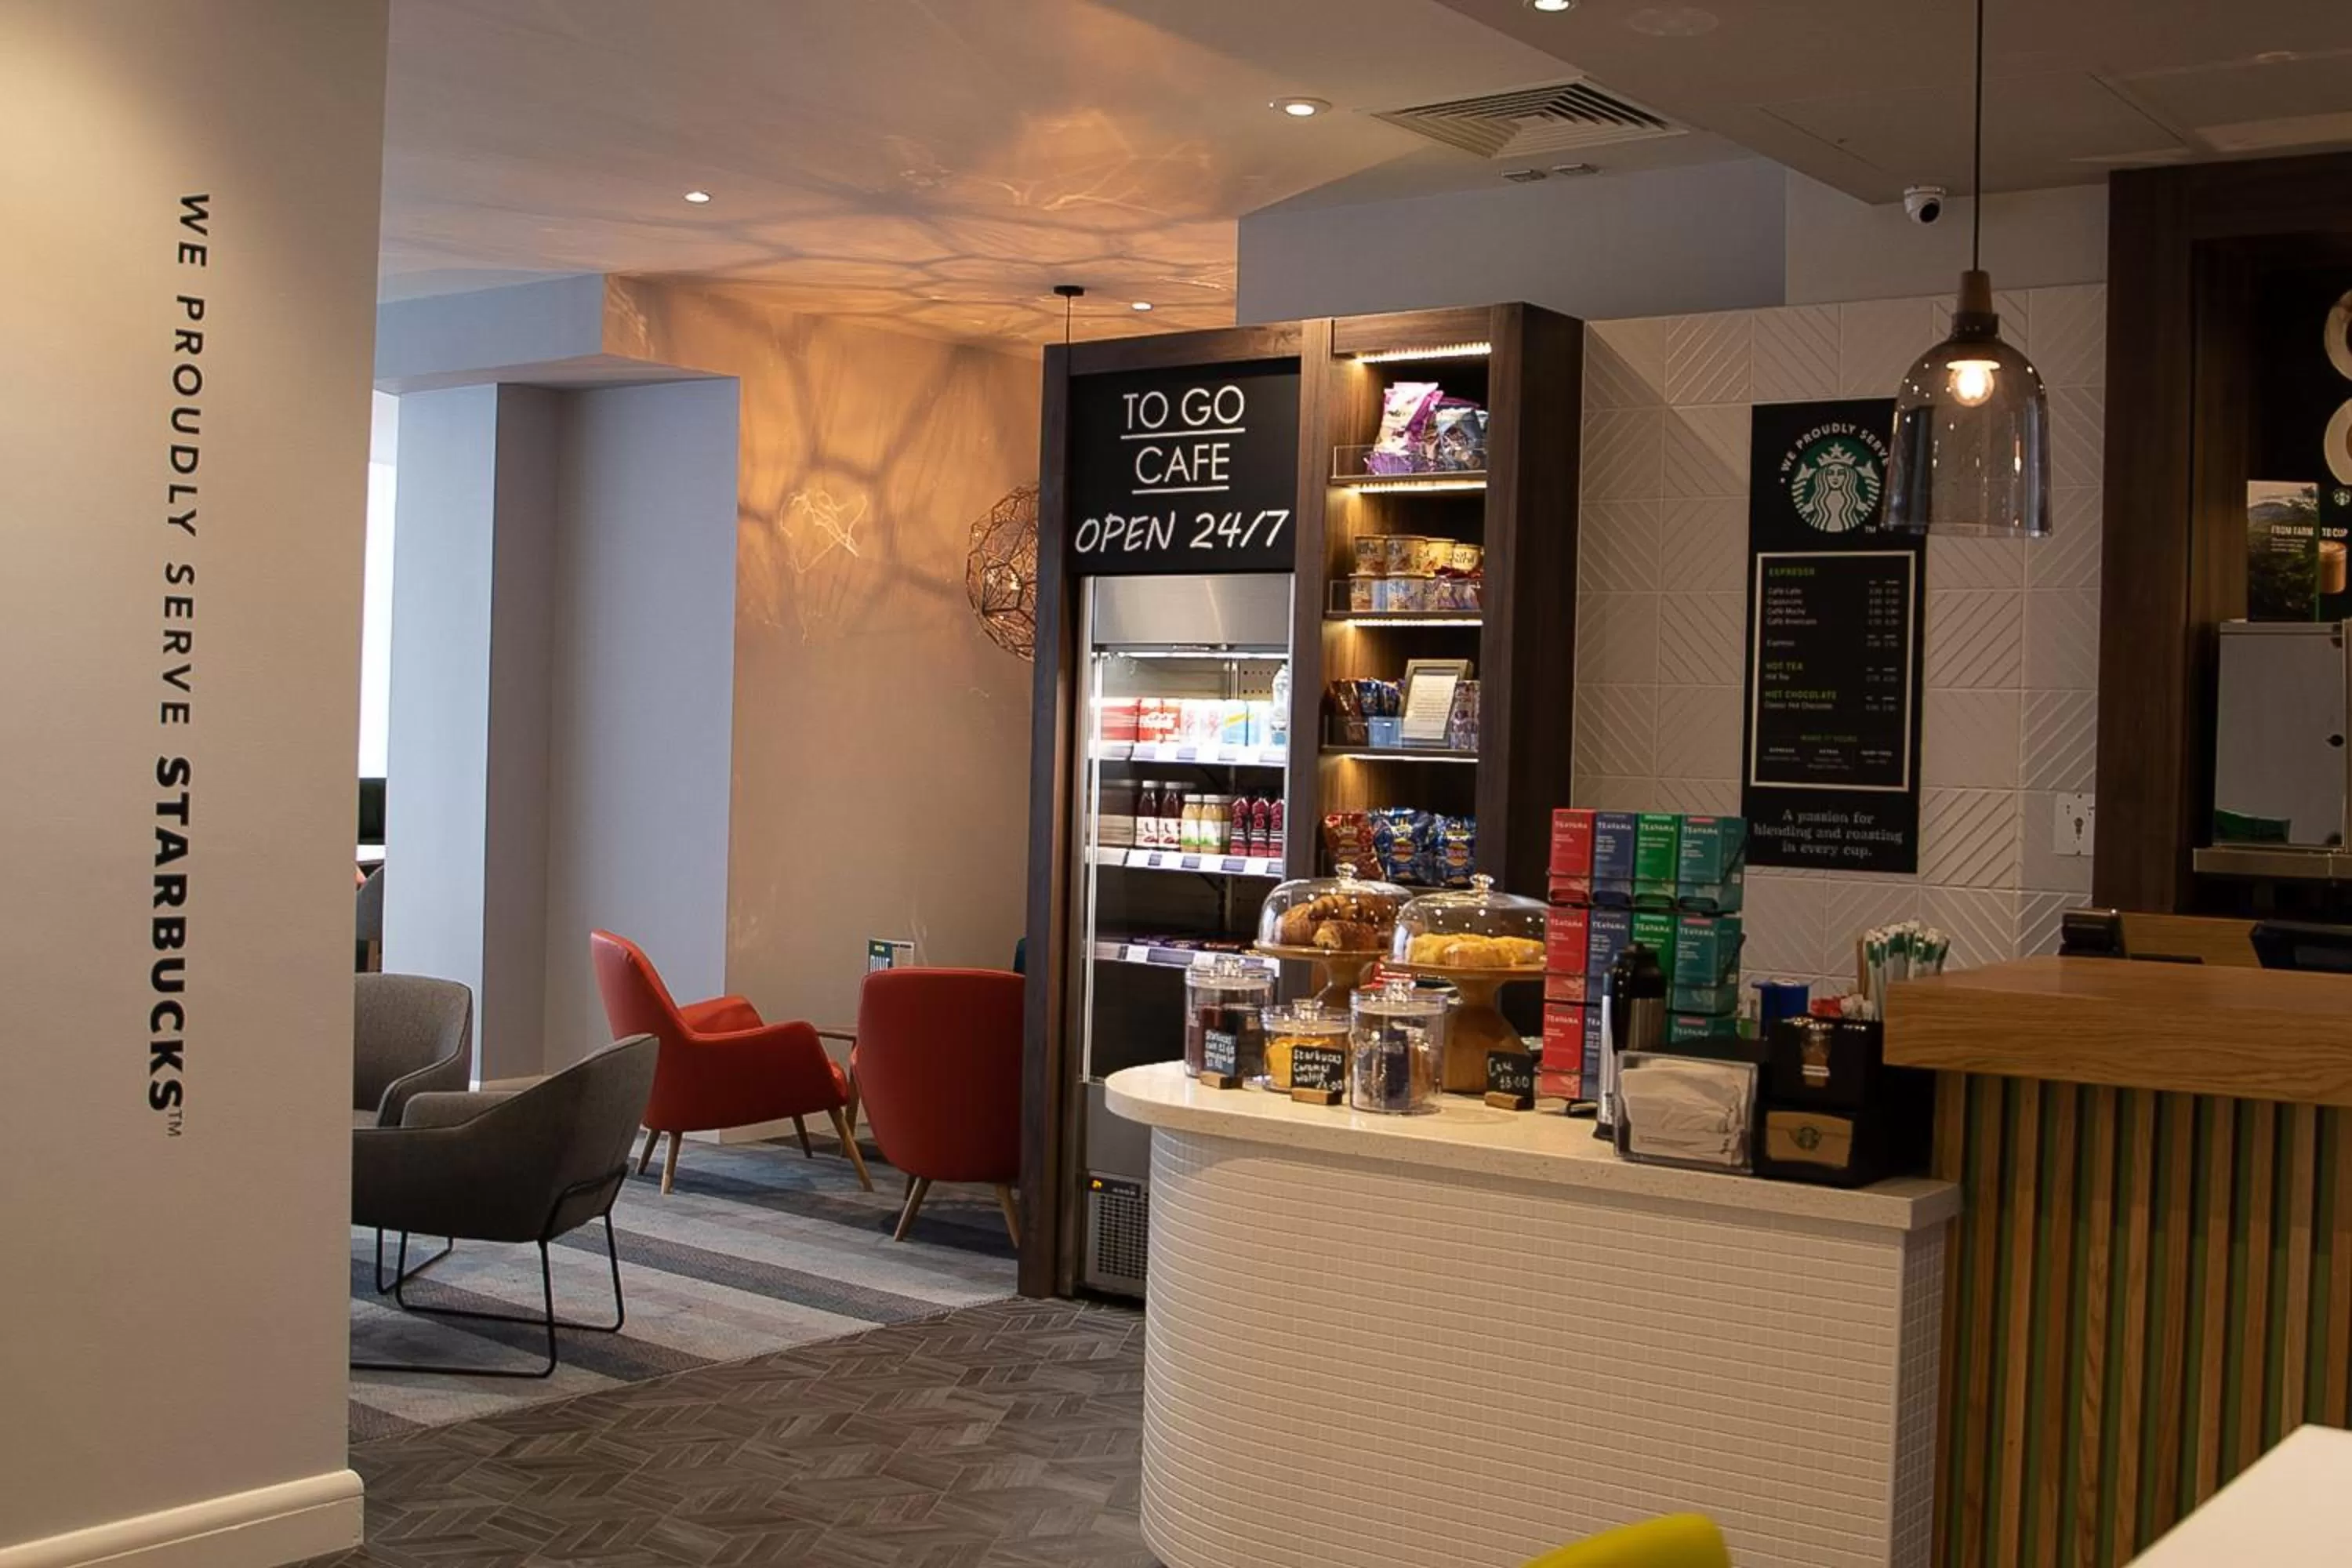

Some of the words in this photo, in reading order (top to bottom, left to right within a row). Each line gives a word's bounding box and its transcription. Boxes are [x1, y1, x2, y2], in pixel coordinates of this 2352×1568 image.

[178, 194, 210, 267] WE
[167, 295, 205, 537] PROUDLY
[1123, 391, 1169, 430] TO
[1181, 385, 1245, 426] GO
[1136, 443, 1230, 484] CAFE
[1780, 449, 1797, 471] WE
[1795, 423, 1857, 449] PROUDLY
[1075, 511, 1175, 553] OPEN
[1189, 510, 1290, 548] 24/7
[2321, 527, 2332, 537] TO
[160, 562, 195, 724] SERVE
[1753, 822, 1813, 840] blending
[1816, 827, 1842, 840] and
[1846, 829, 1904, 845] roasting
[1782, 809, 1794, 822] A
[1797, 811, 1849, 825] passion
[1853, 811, 1875, 825] for
[1781, 840, 1796, 853] in
[1800, 844, 1838, 857] every
[1843, 846, 1873, 859] cup.
[148, 756, 191, 1112] STARBUCKS
